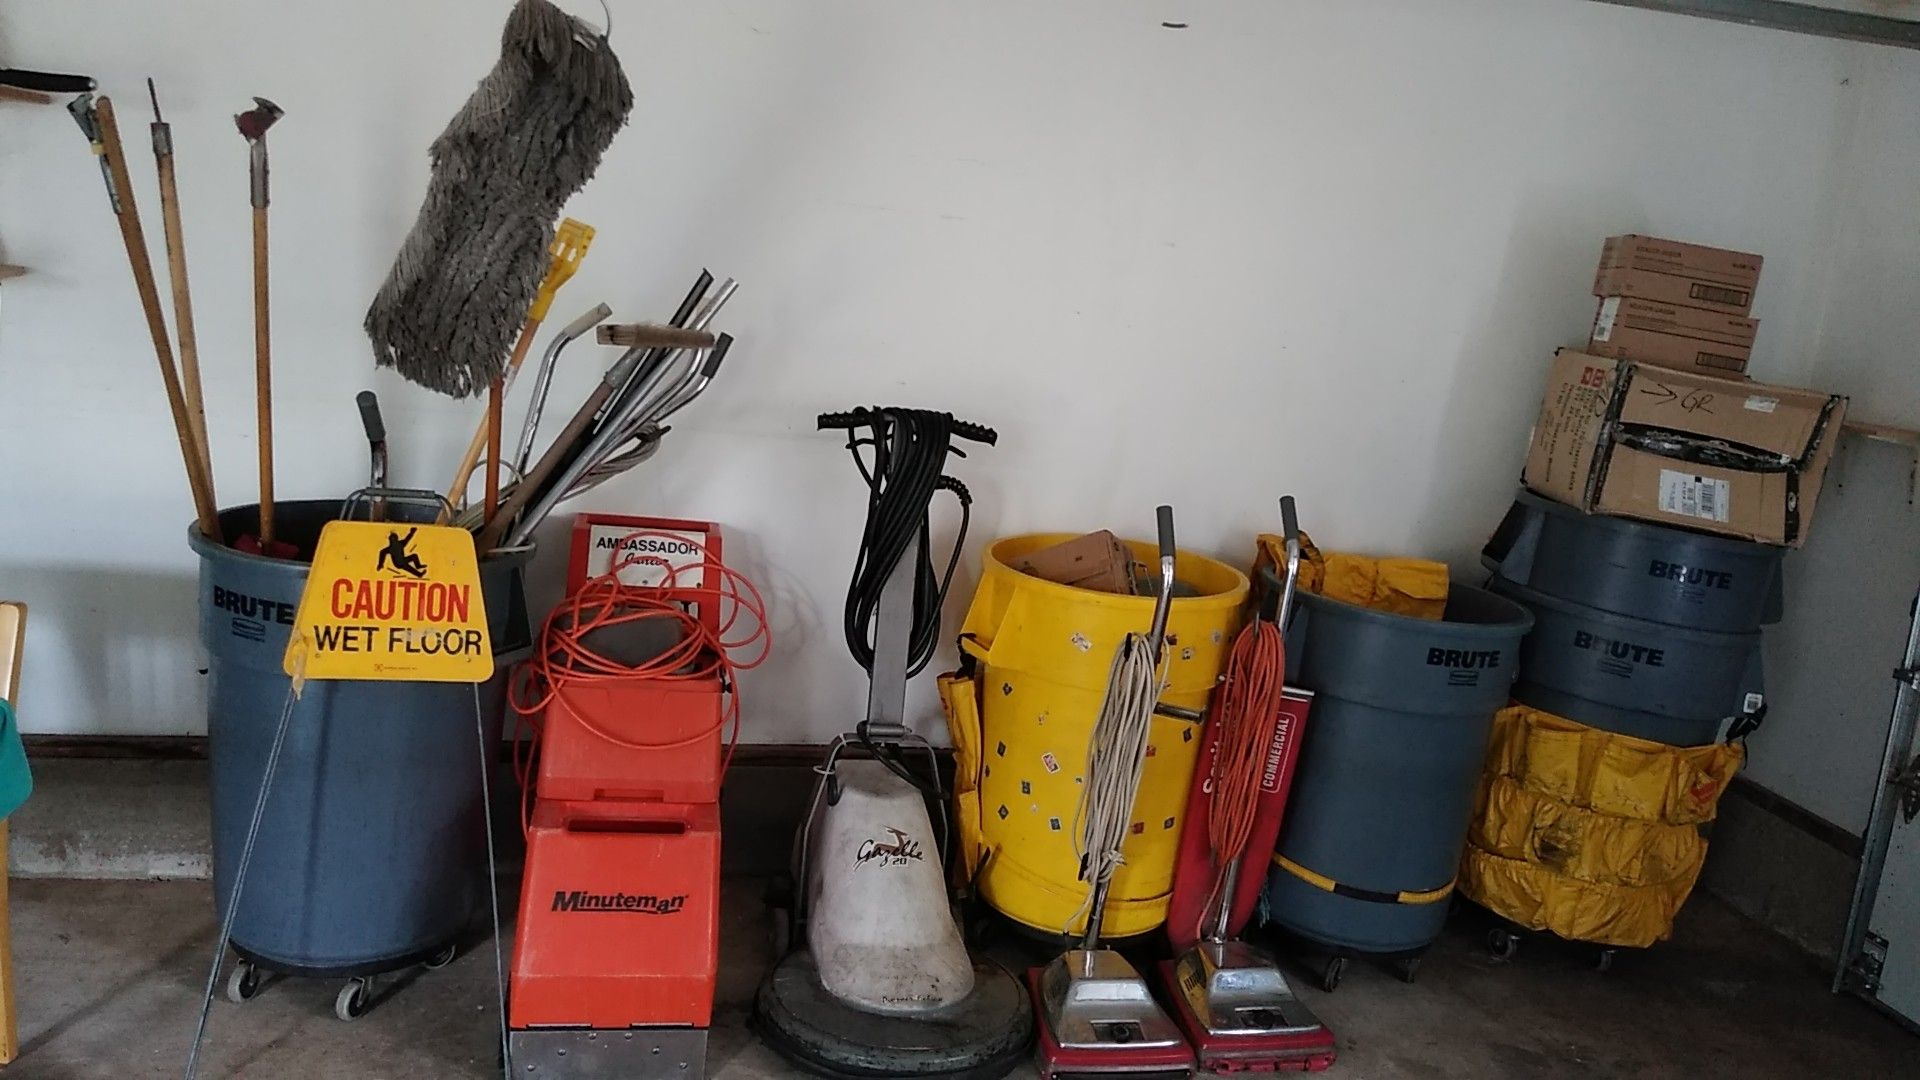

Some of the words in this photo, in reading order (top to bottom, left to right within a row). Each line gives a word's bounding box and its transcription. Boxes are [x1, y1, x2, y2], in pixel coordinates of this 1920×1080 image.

[596, 536, 699, 556] AMBASSADOR
[1648, 559, 1732, 590] BRUTE
[213, 584, 295, 626] BRUTE
[331, 577, 470, 623] CAUTION
[314, 625, 380, 652] WET
[388, 627, 482, 656] FLOOR
[1426, 647, 1501, 669] BRUTE
[1262, 717, 1290, 788] COMMERCIAL
[856, 838, 925, 868] Gazelle
[552, 890, 685, 912] Minuteman
